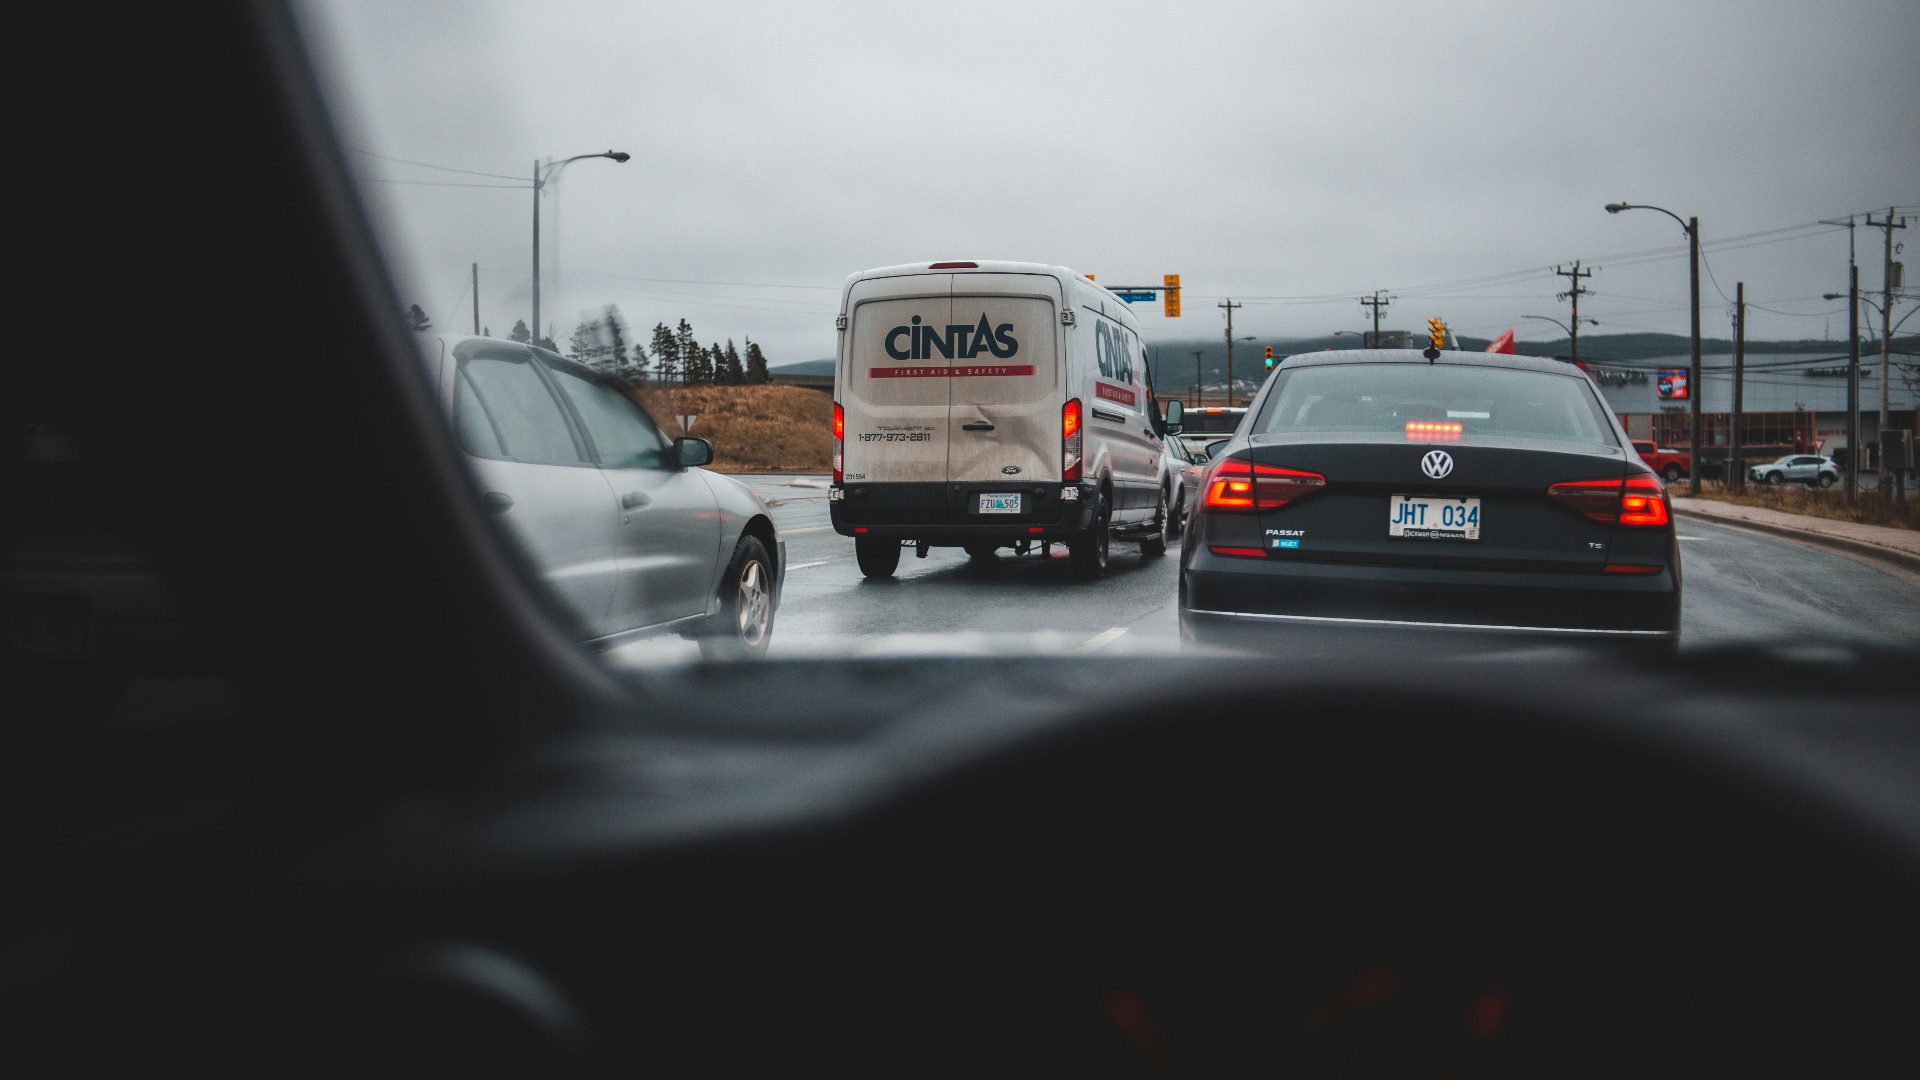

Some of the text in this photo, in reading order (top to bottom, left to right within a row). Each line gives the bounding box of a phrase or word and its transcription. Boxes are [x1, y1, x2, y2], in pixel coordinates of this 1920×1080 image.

[967, 367, 1007, 375] SAFETY
[858, 433, 931, 442] 1-877-973-2811
[981, 499, 1019, 508] FZU 505
[1392, 503, 1478, 527] JHT 034
